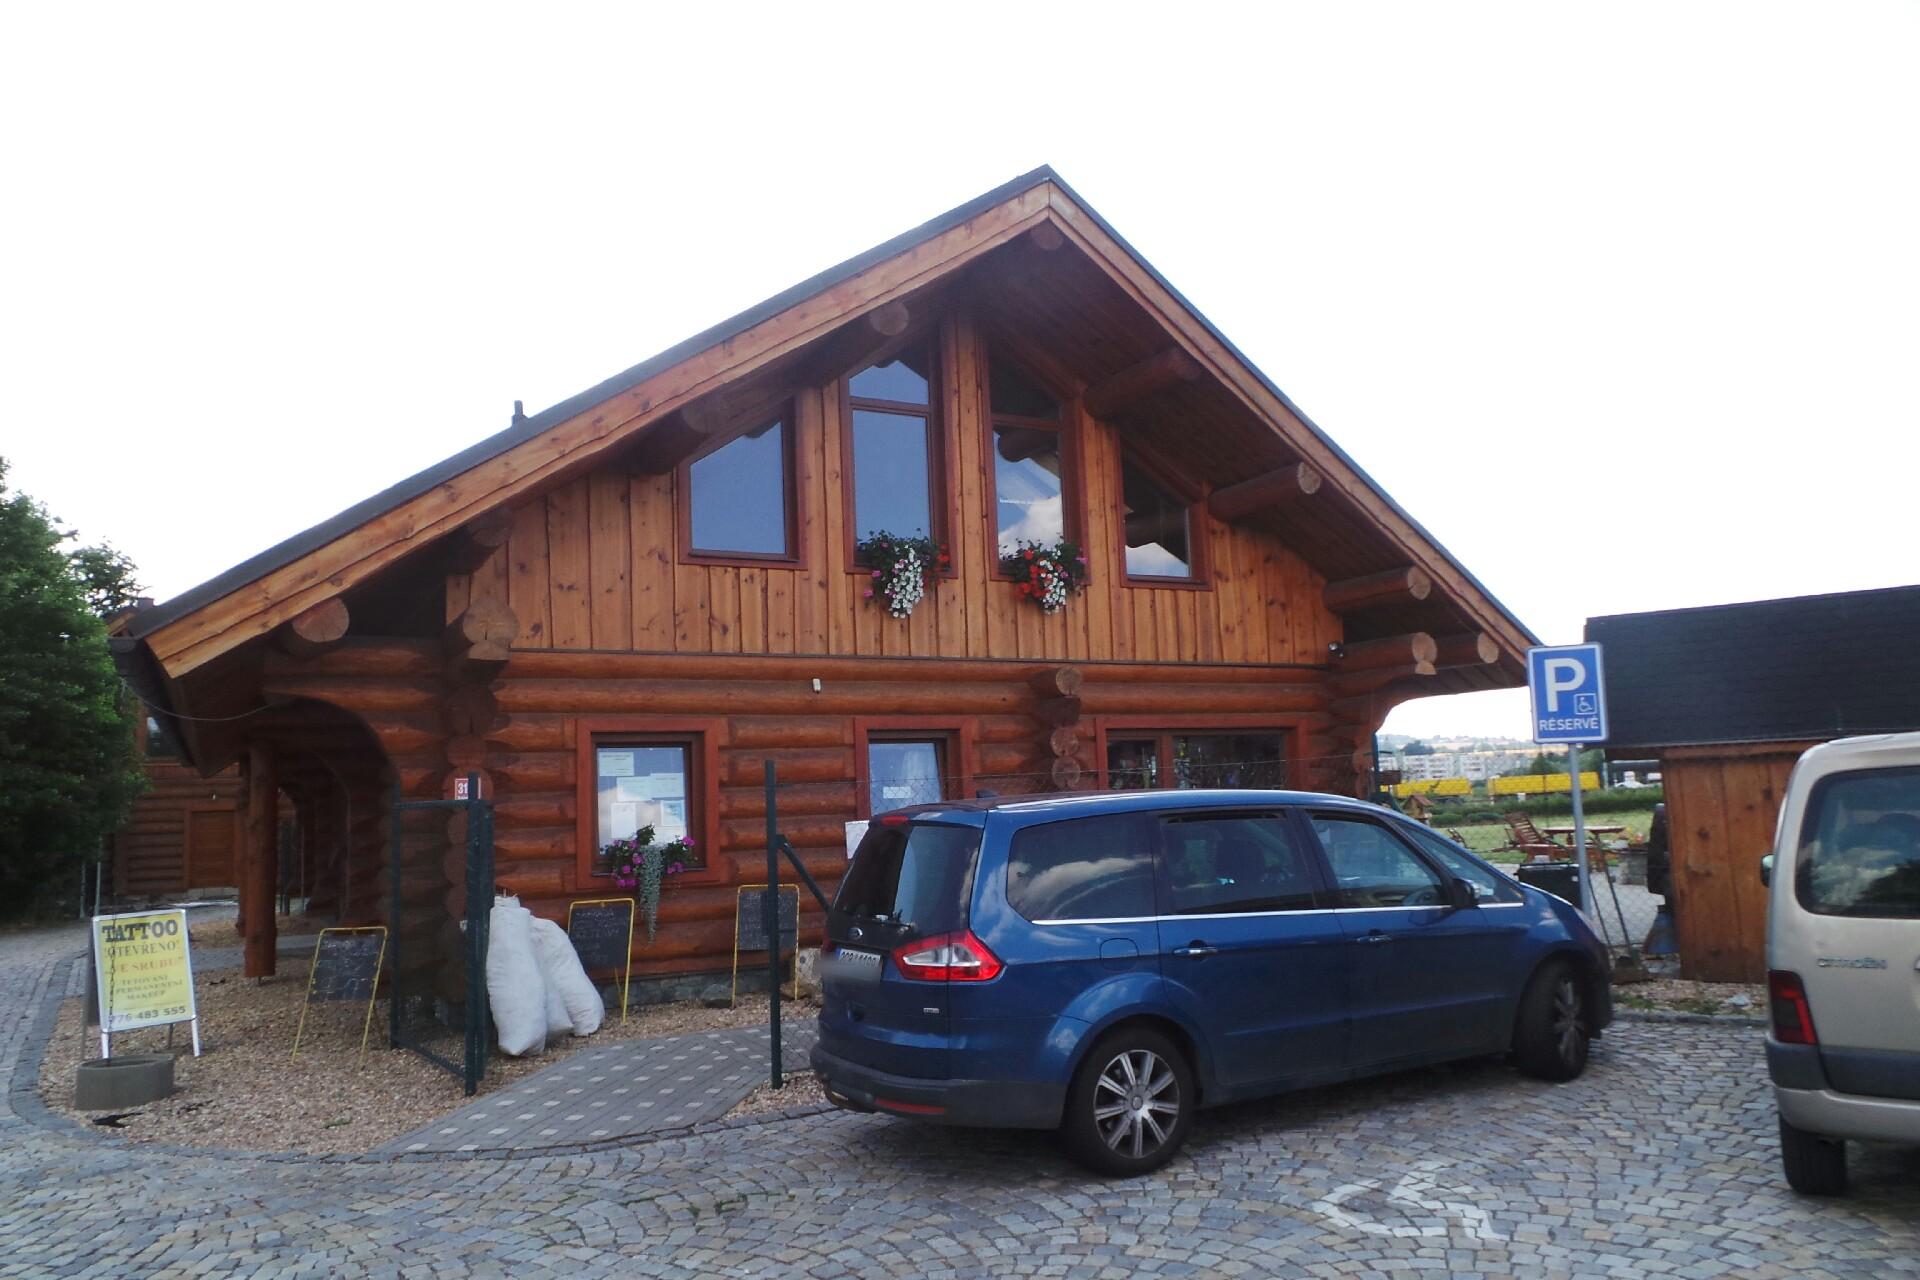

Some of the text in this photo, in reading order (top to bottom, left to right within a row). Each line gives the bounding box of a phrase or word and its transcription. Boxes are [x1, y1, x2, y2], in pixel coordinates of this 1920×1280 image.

[1544, 658, 1585, 712] P
[1539, 716, 1599, 731] RÉSERVÉ
[102, 920, 178, 942] TATTOO
[163, 1005, 186, 1016] 555
